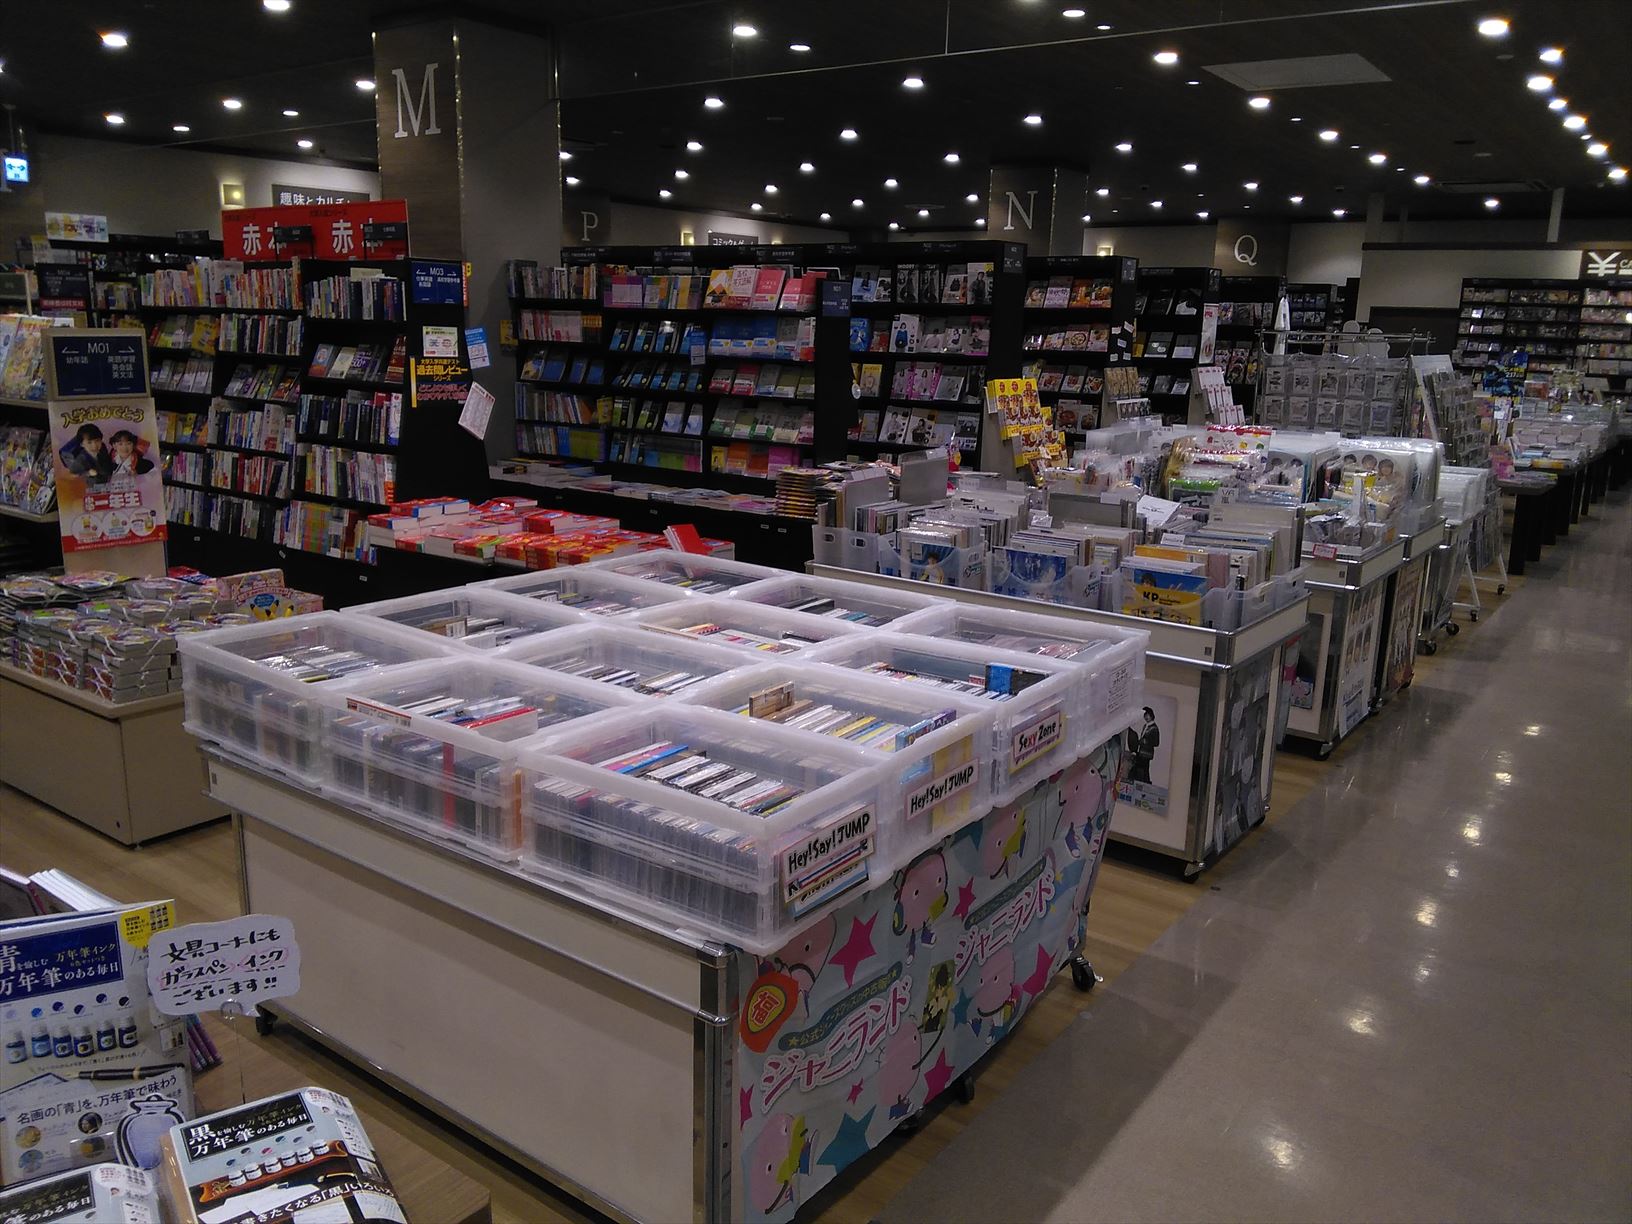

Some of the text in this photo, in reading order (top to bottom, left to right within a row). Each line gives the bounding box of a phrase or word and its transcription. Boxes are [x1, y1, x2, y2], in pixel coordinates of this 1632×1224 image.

[392, 63, 441, 138] M
[1004, 190, 1039, 230] N
[580, 211, 599, 242] P
[1234, 235, 1258, 266] Q
[429, 267, 444, 276] M03
[87, 342, 110, 355] M01
[416, 365, 468, 376] 過去問レビュー
[61, 405, 145, 428] 入学おめでとう
[1019, 731, 1037, 752] Sexy
[1038, 722, 1056, 741] Zone
[56, 944, 116, 962] 万年筆インク
[162, 929, 280, 964] 文具コーナーにも
[0, 963, 119, 996] 万年筆のある毎日
[191, 1113, 308, 1158] 万年筆のある毎日
